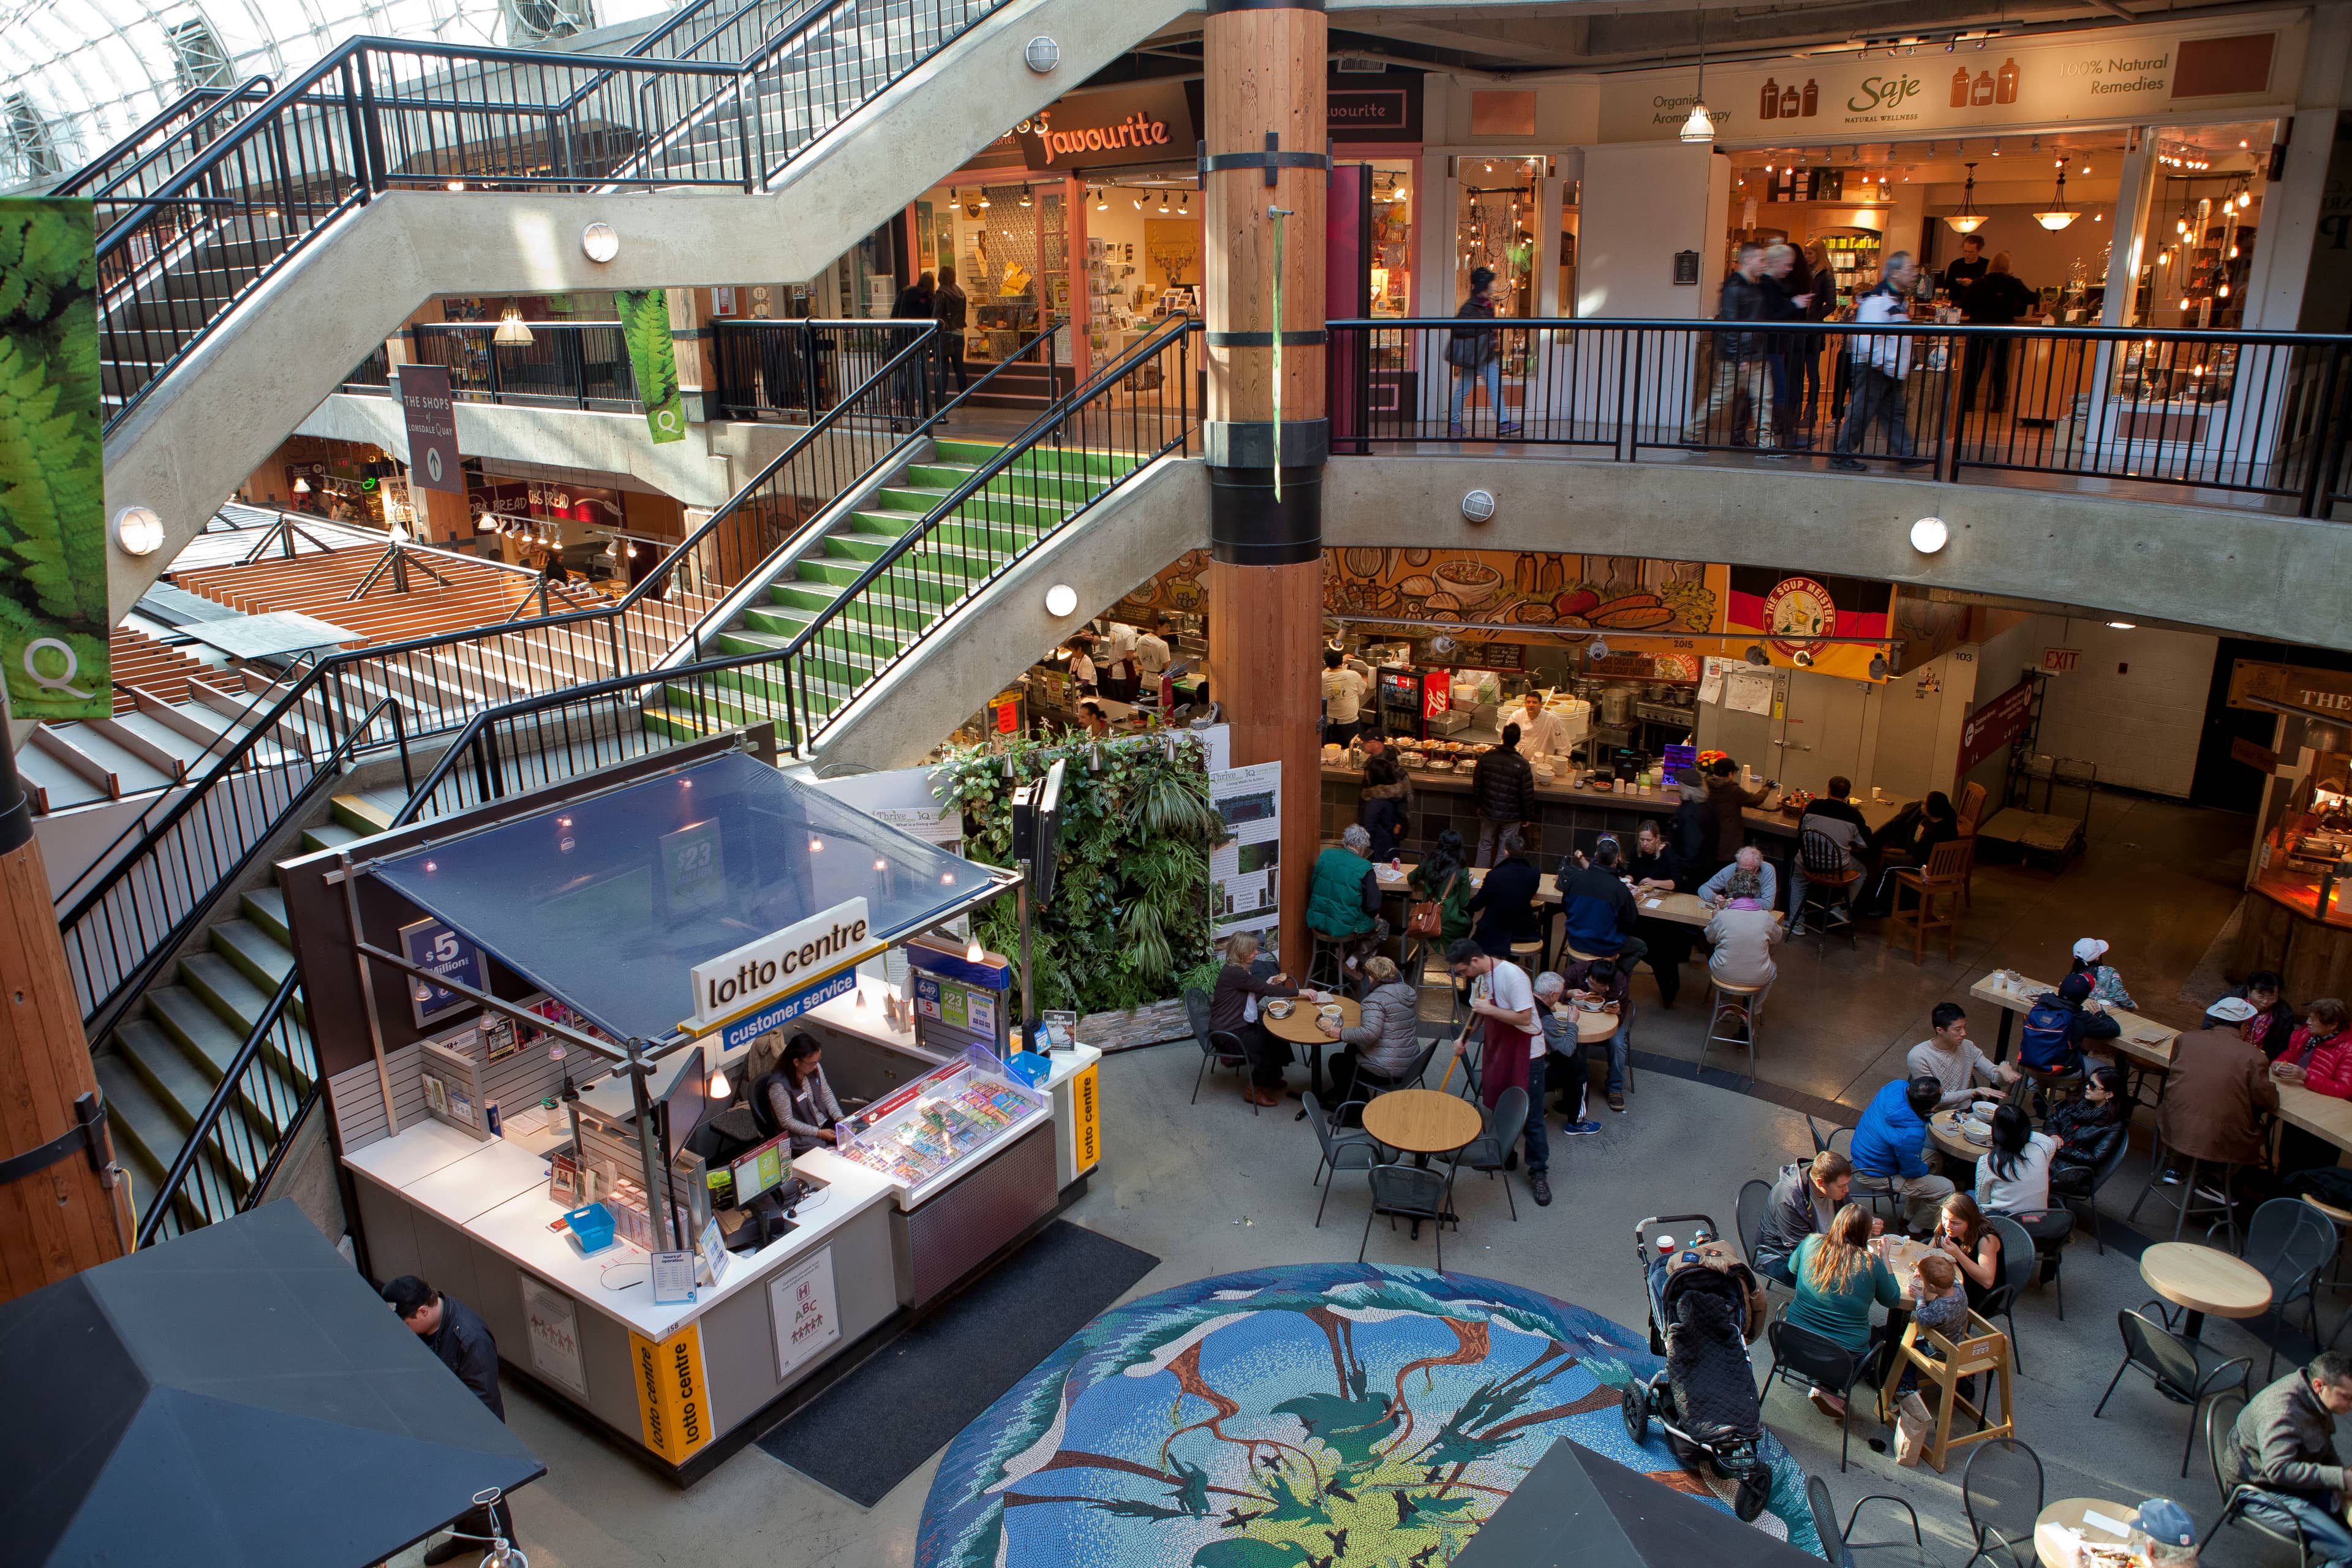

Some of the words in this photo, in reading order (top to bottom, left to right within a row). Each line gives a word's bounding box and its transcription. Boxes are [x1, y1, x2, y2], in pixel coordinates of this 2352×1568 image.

[2059, 60, 2103, 77] 100%
[2108, 53, 2169, 73] Natural
[1847, 74, 1921, 112] Saje
[2090, 76, 2164, 94] Remedies
[404, 395, 421, 407] THE
[423, 397, 449, 410] SHOPS
[426, 412, 431, 423] of
[658, 410, 680, 434] Q
[408, 423, 435, 434] LONSDALE
[435, 423, 452, 437] QUAY
[493, 497, 527, 513] BREAD
[545, 491, 568, 510] BREAD
[1765, 597, 1778, 614] THE
[1777, 581, 1803, 595] SOUP
[1807, 583, 1833, 622] MEISTER
[1955, 652, 1972, 662] 103
[2045, 651, 2080, 670] EXIT
[24, 638, 97, 699] Q
[2300, 690, 2351, 710] THE
[1211, 771, 1236, 781] Thrive
[877, 810, 907, 820] Thrive
[709, 960, 777, 1008] lotto
[782, 918, 867, 974] centre
[944, 992, 962, 1008] $23
[944, 1004, 964, 1014] MILLION
[729, 1001, 800, 1046] customer
[803, 976, 853, 1010] service
[1084, 1076, 1093, 1123] centre
[1085, 1126, 1094, 1160] lotto
[763, 1156, 774, 1168] 23
[795, 1299, 818, 1324] ABC
[667, 1322, 679, 1334] 158
[641, 1347, 658, 1404] centre
[675, 1343, 693, 1398] centre
[650, 1408, 664, 1449] lotto
[683, 1403, 699, 1445] lotto
